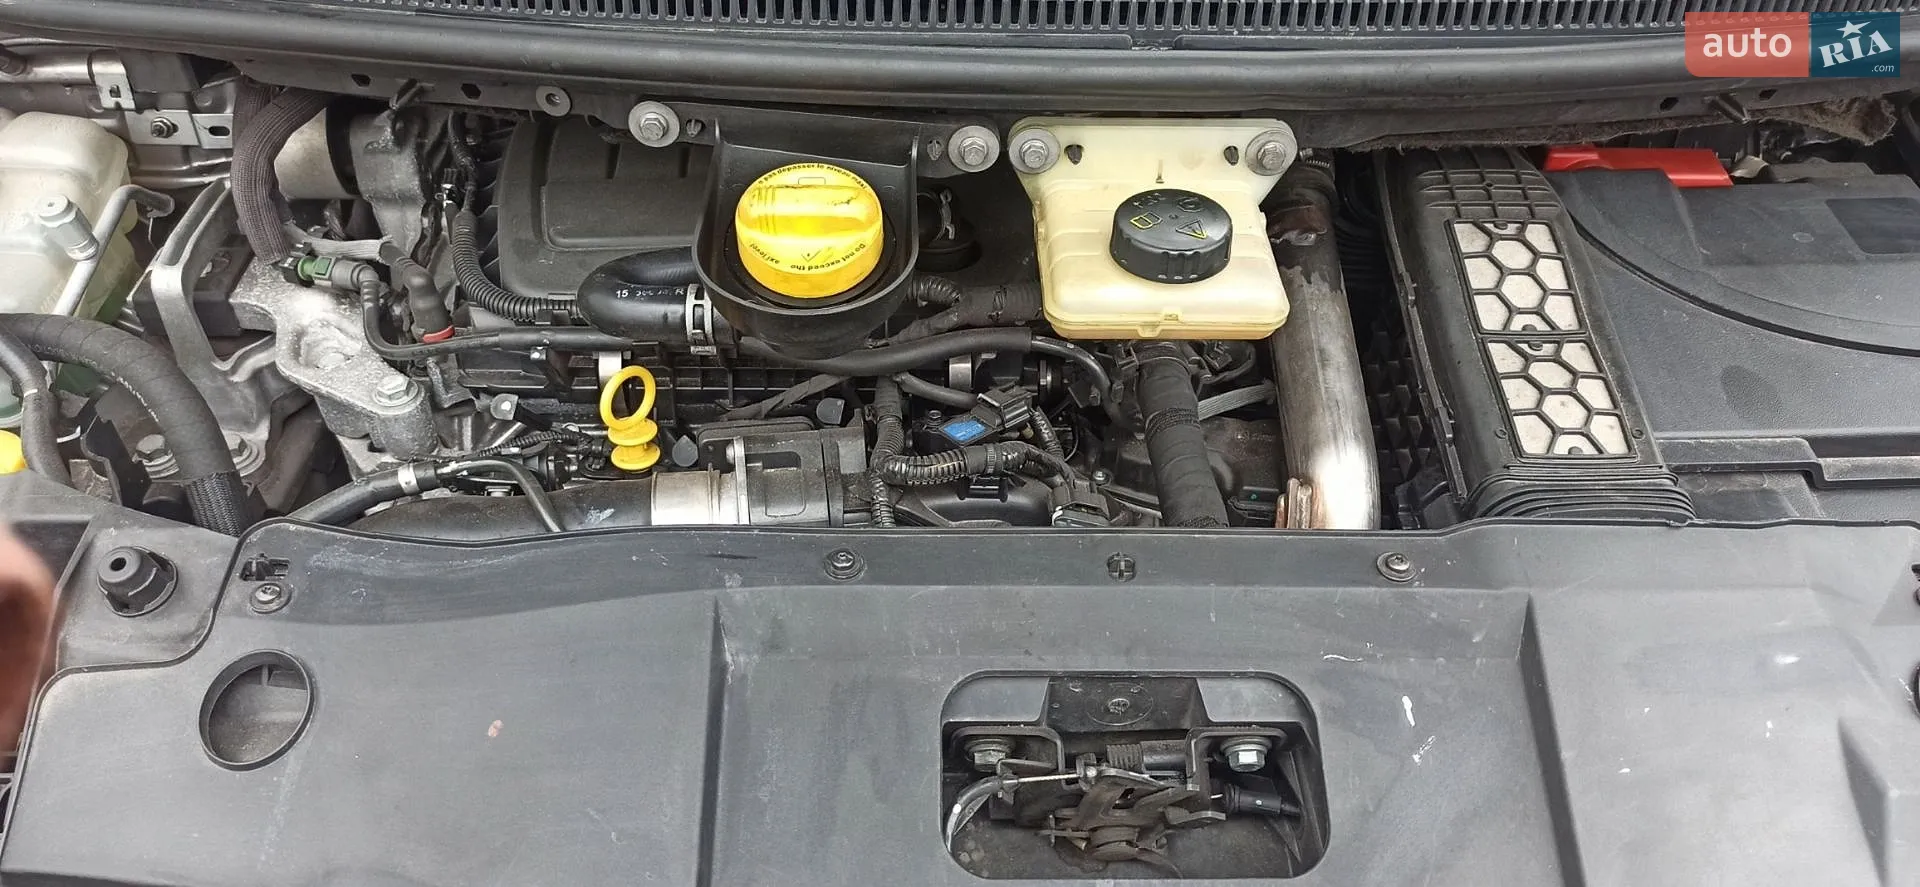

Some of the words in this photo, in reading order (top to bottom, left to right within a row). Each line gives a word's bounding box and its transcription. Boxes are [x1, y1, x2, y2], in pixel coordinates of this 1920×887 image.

[763, 171, 777, 182] pas
[826, 166, 850, 177] niveau
[851, 176, 867, 190] maxi
[855, 243, 866, 252] Do
[841, 252, 855, 262] not
[807, 259, 840, 271] exceed
